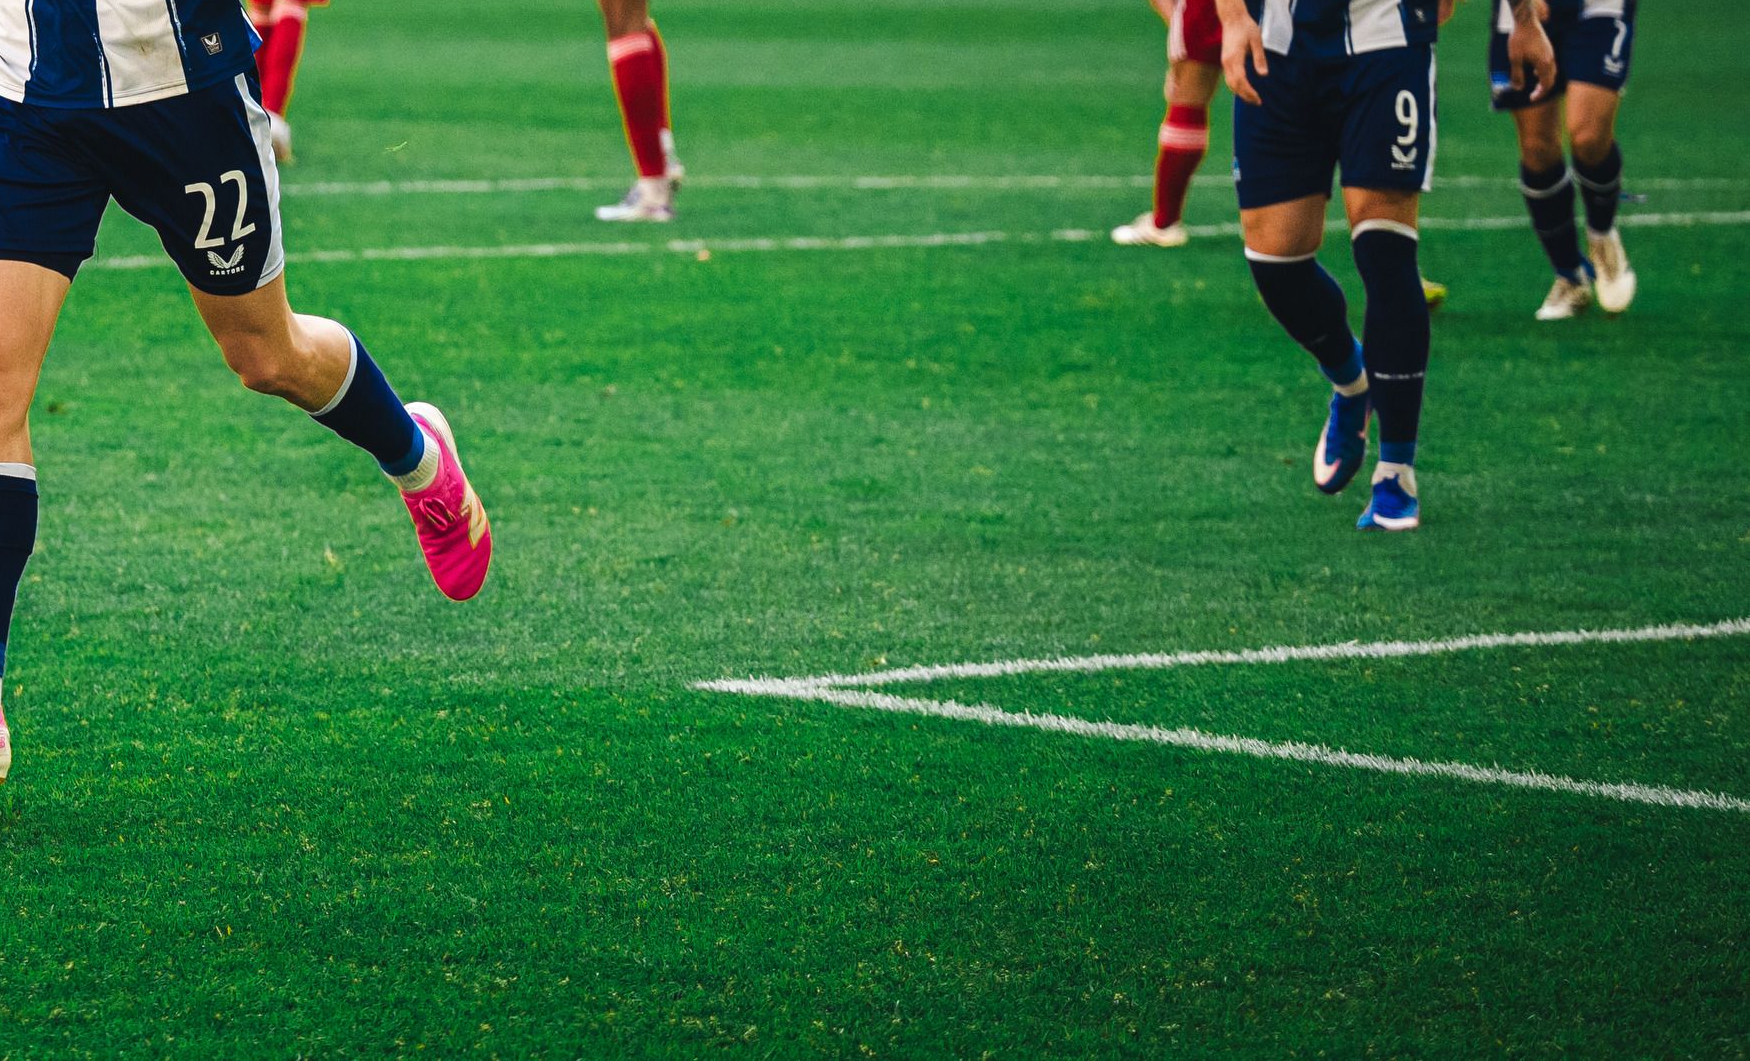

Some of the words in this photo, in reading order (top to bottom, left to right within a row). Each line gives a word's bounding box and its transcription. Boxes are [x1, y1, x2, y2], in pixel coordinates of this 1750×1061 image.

[1613, 19, 1627, 58] 7
[1395, 90, 1418, 145] 9
[185, 169, 256, 249] 22
